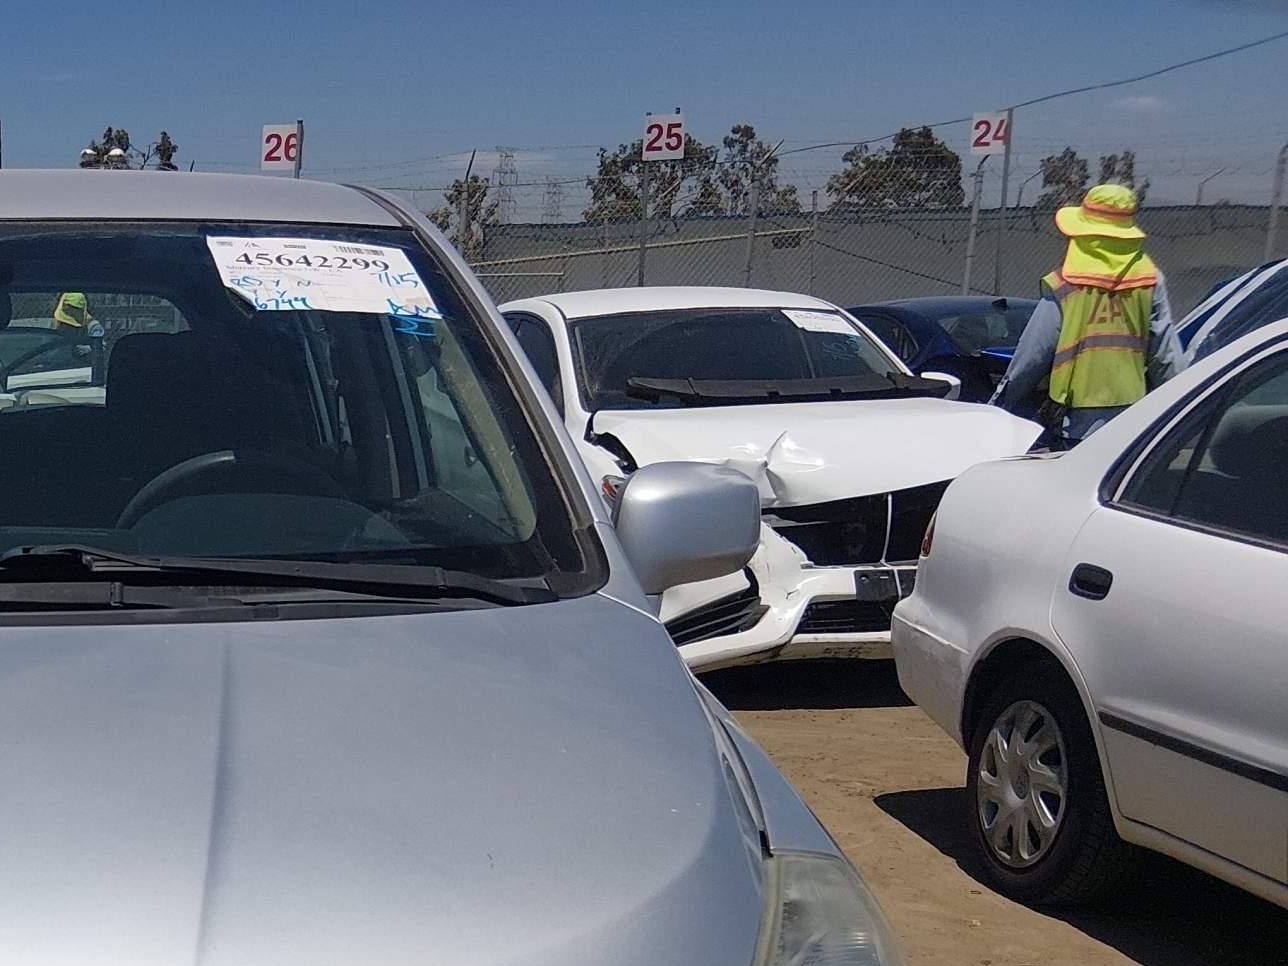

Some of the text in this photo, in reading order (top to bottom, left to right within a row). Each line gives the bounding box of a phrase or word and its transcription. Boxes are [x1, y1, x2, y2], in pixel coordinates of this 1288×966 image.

[645, 123, 682, 152] 25
[973, 119, 1009, 147] 24
[264, 133, 297, 162] 26
[235, 252, 390, 272] 45642299
